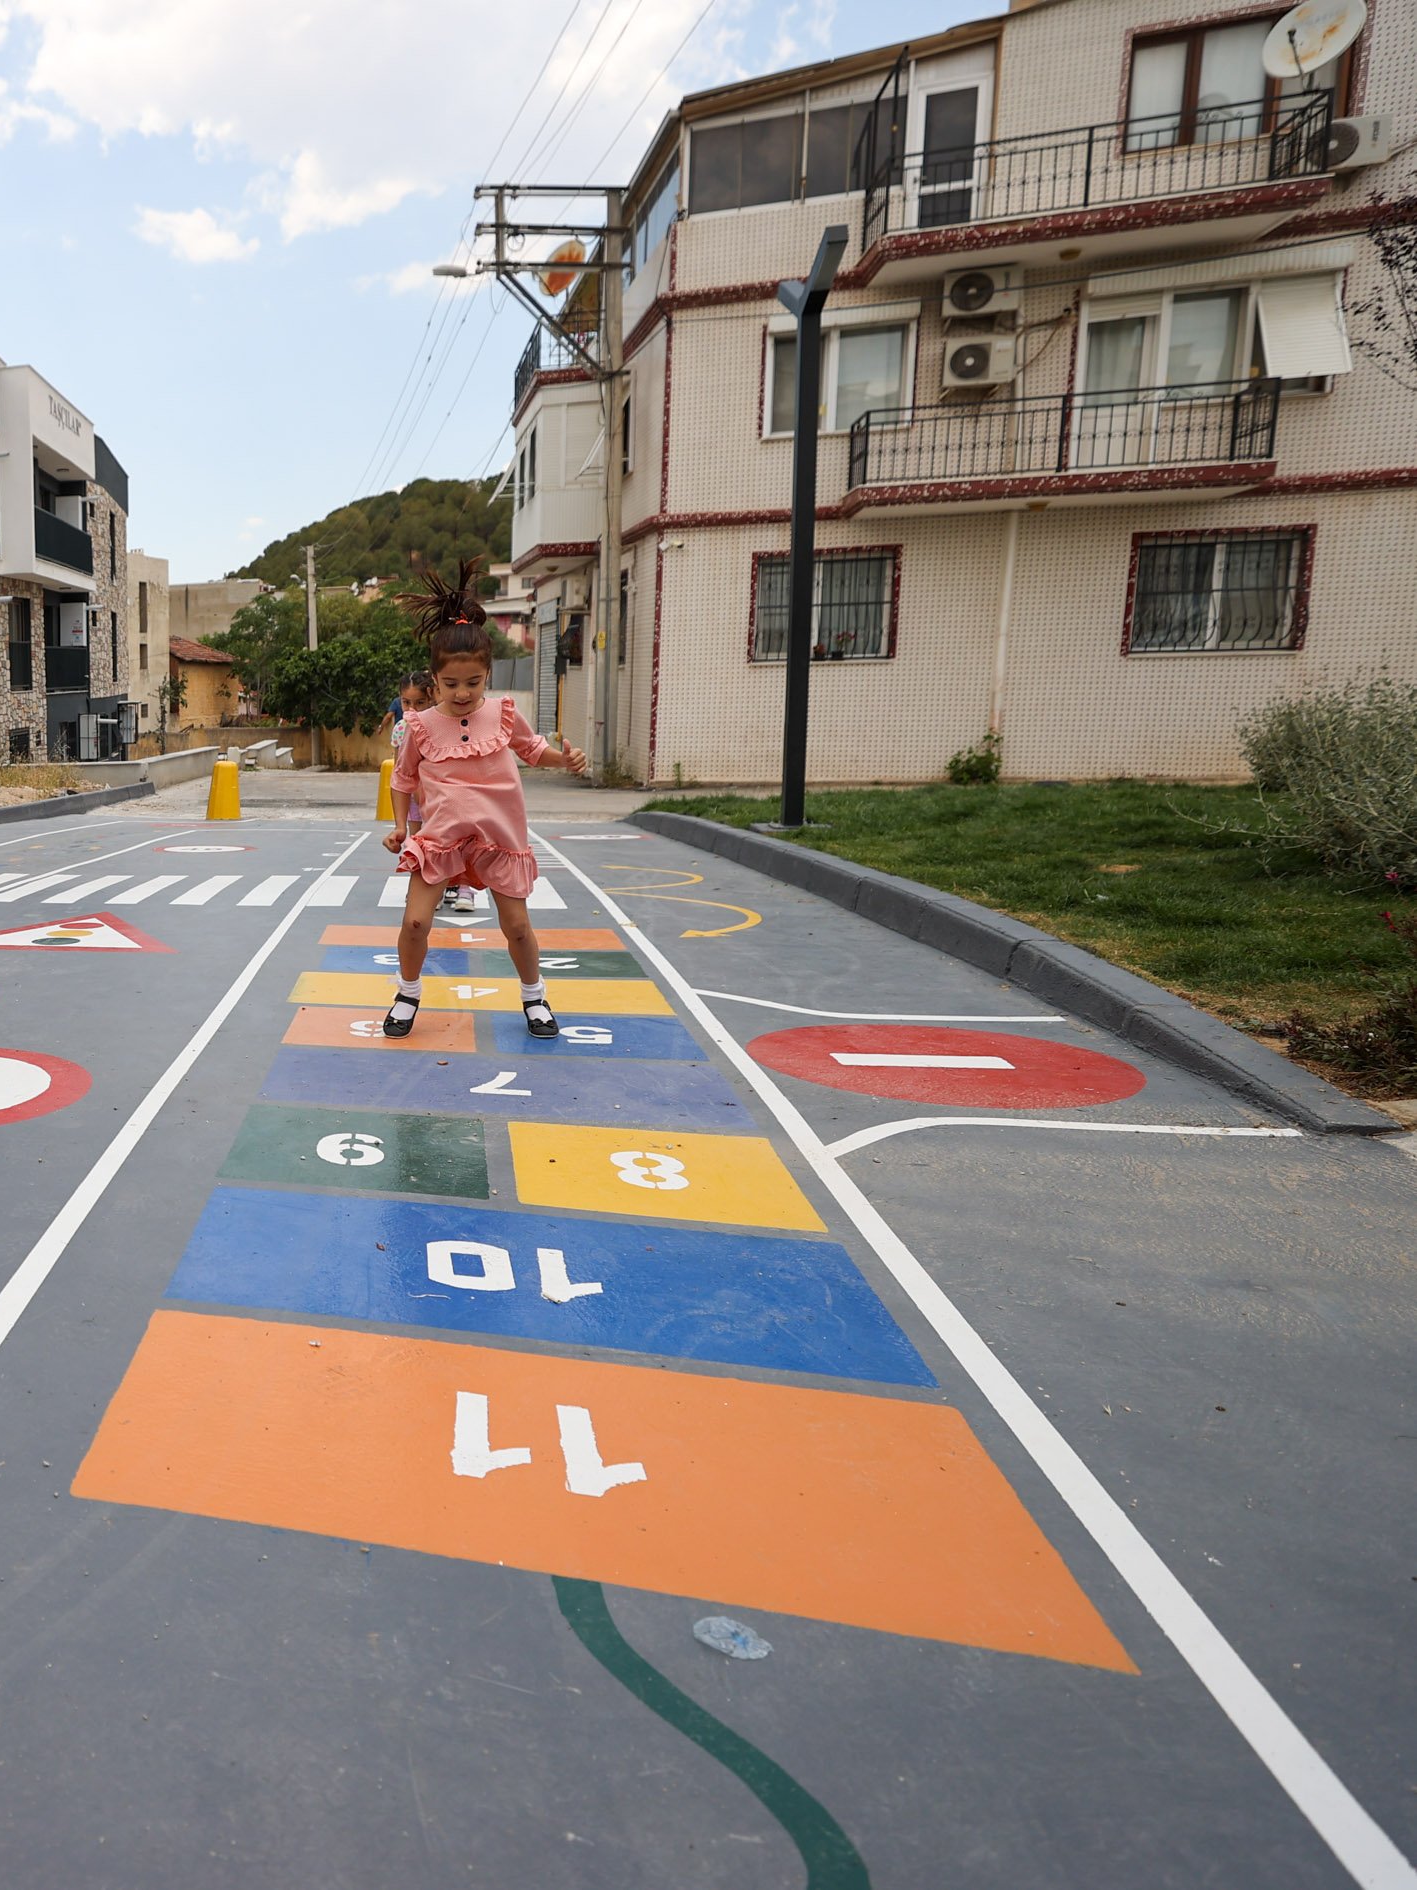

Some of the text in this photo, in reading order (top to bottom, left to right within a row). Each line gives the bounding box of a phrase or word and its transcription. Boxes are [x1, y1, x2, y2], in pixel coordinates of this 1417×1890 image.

[460, 933, 486, 943] 1
[372, 954, 400, 966] 3
[539, 957, 580, 969] 2
[449, 984, 499, 999] 4
[349, 1020, 386, 1038] 6
[559, 1025, 613, 1044] 5
[470, 1071, 532, 1096] 7
[316, 1132, 385, 1166] 9
[610, 1151, 690, 1190] 8
[427, 1240, 603, 1303] 10
[450, 1391, 648, 1497] 11
